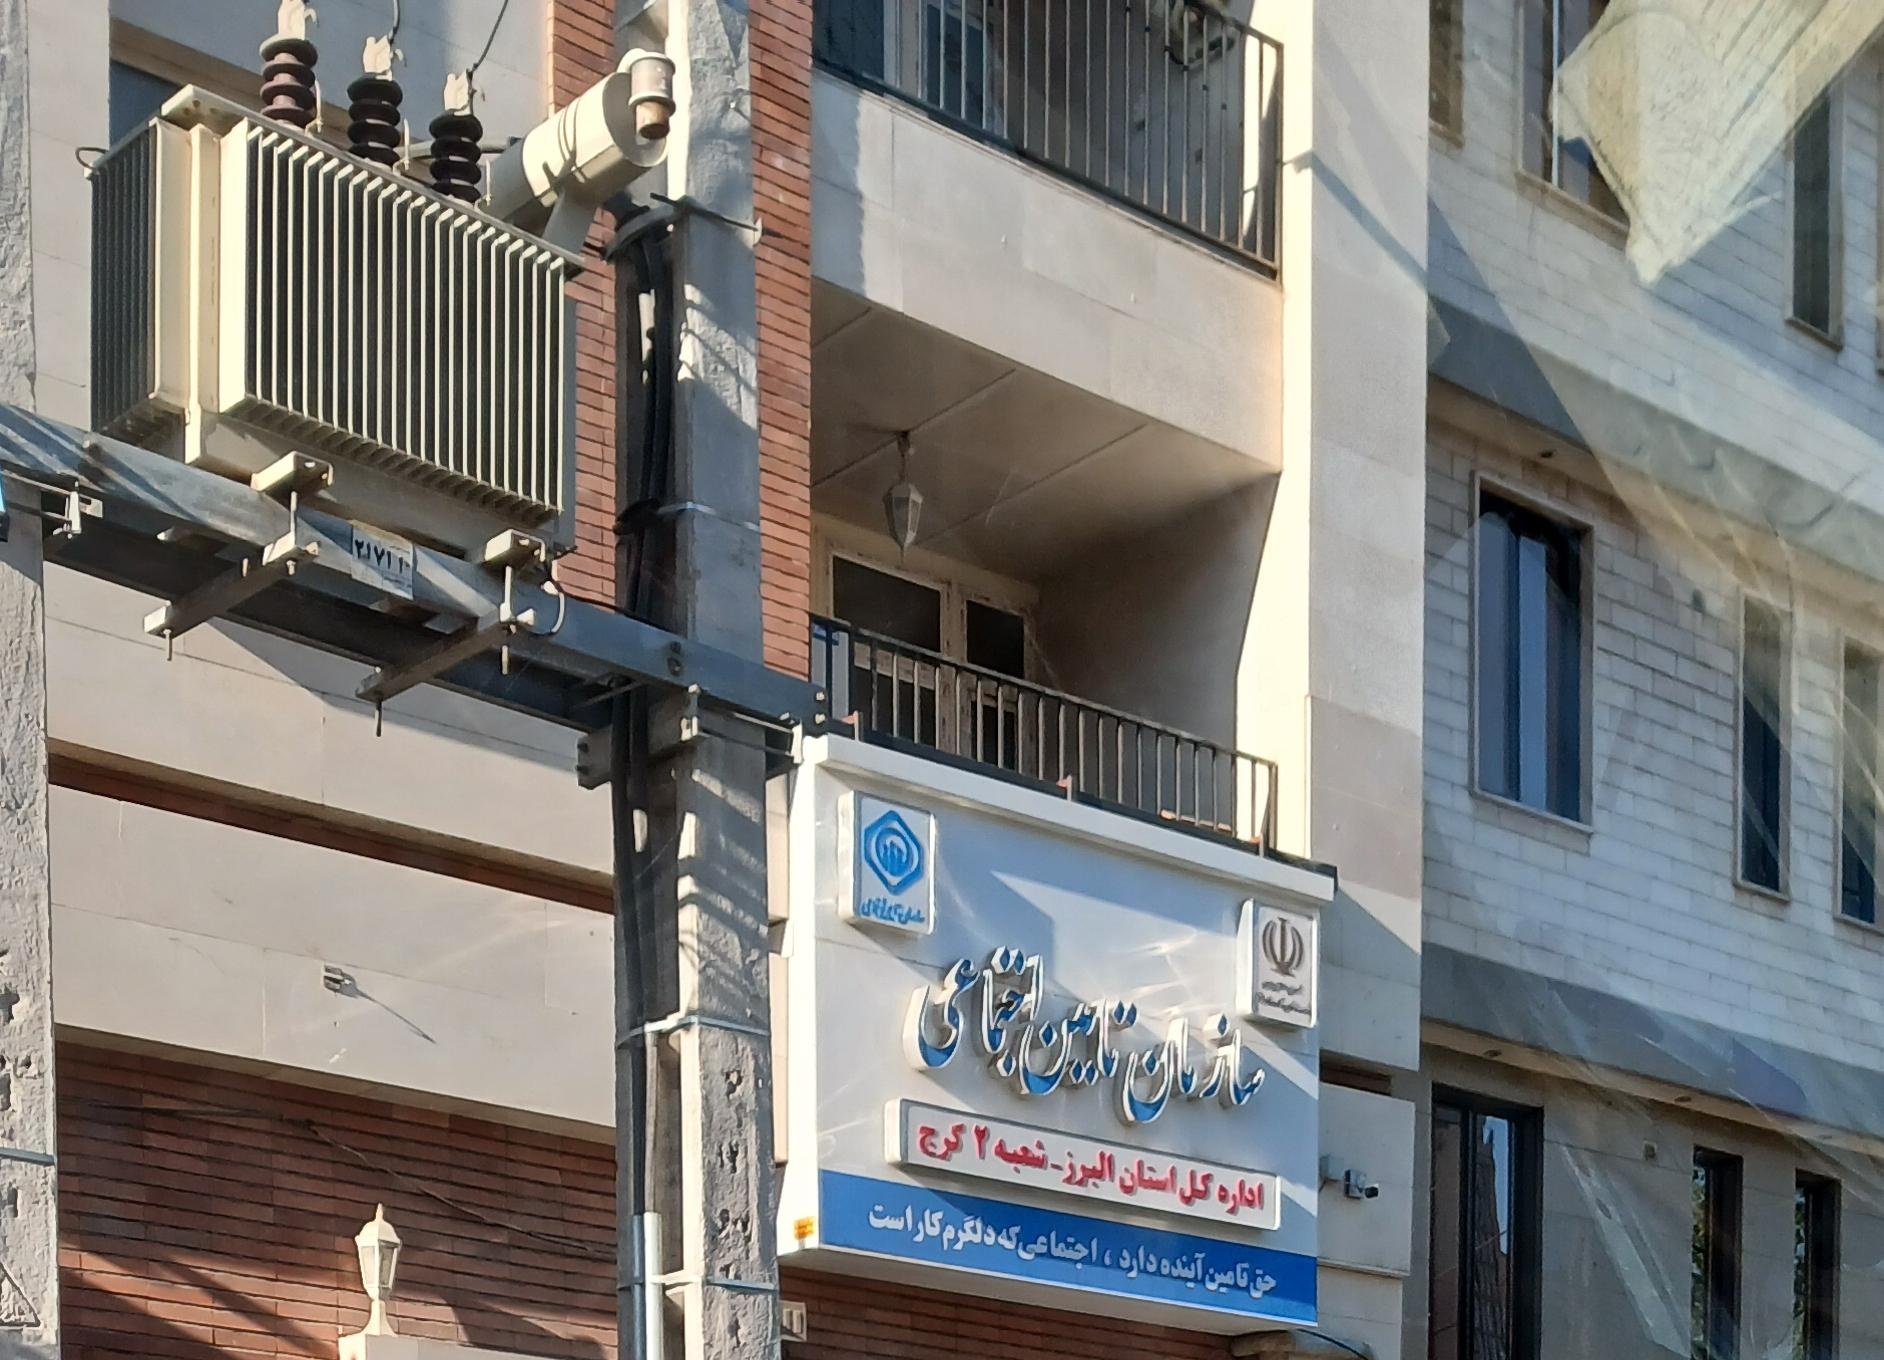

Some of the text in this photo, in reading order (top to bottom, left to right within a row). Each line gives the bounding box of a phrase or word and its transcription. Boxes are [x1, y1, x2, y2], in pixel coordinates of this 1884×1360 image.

[904, 946, 1044, 1077] اجتماعی
[1122, 1012, 1266, 1124] سازمان
[918, 1123, 966, 1160] کرج
[972, 1124, 989, 1160] ۲
[1119, 1158, 1177, 1195] استان
[1179, 1169, 1212, 1206] کل
[1217, 1178, 1265, 1215] اداره
[868, 1204, 913, 1232] است
[913, 1208, 944, 1243] کار
[942, 1215, 996, 1251] دلگرم
[1017, 1230, 1098, 1270] اجتماعی
[1119, 1245, 1157, 1279] دارد
[1160, 1252, 1206, 1289] آینده
[1205, 1262, 1250, 1294] تامین
[1250, 1269, 1277, 1299] حق
